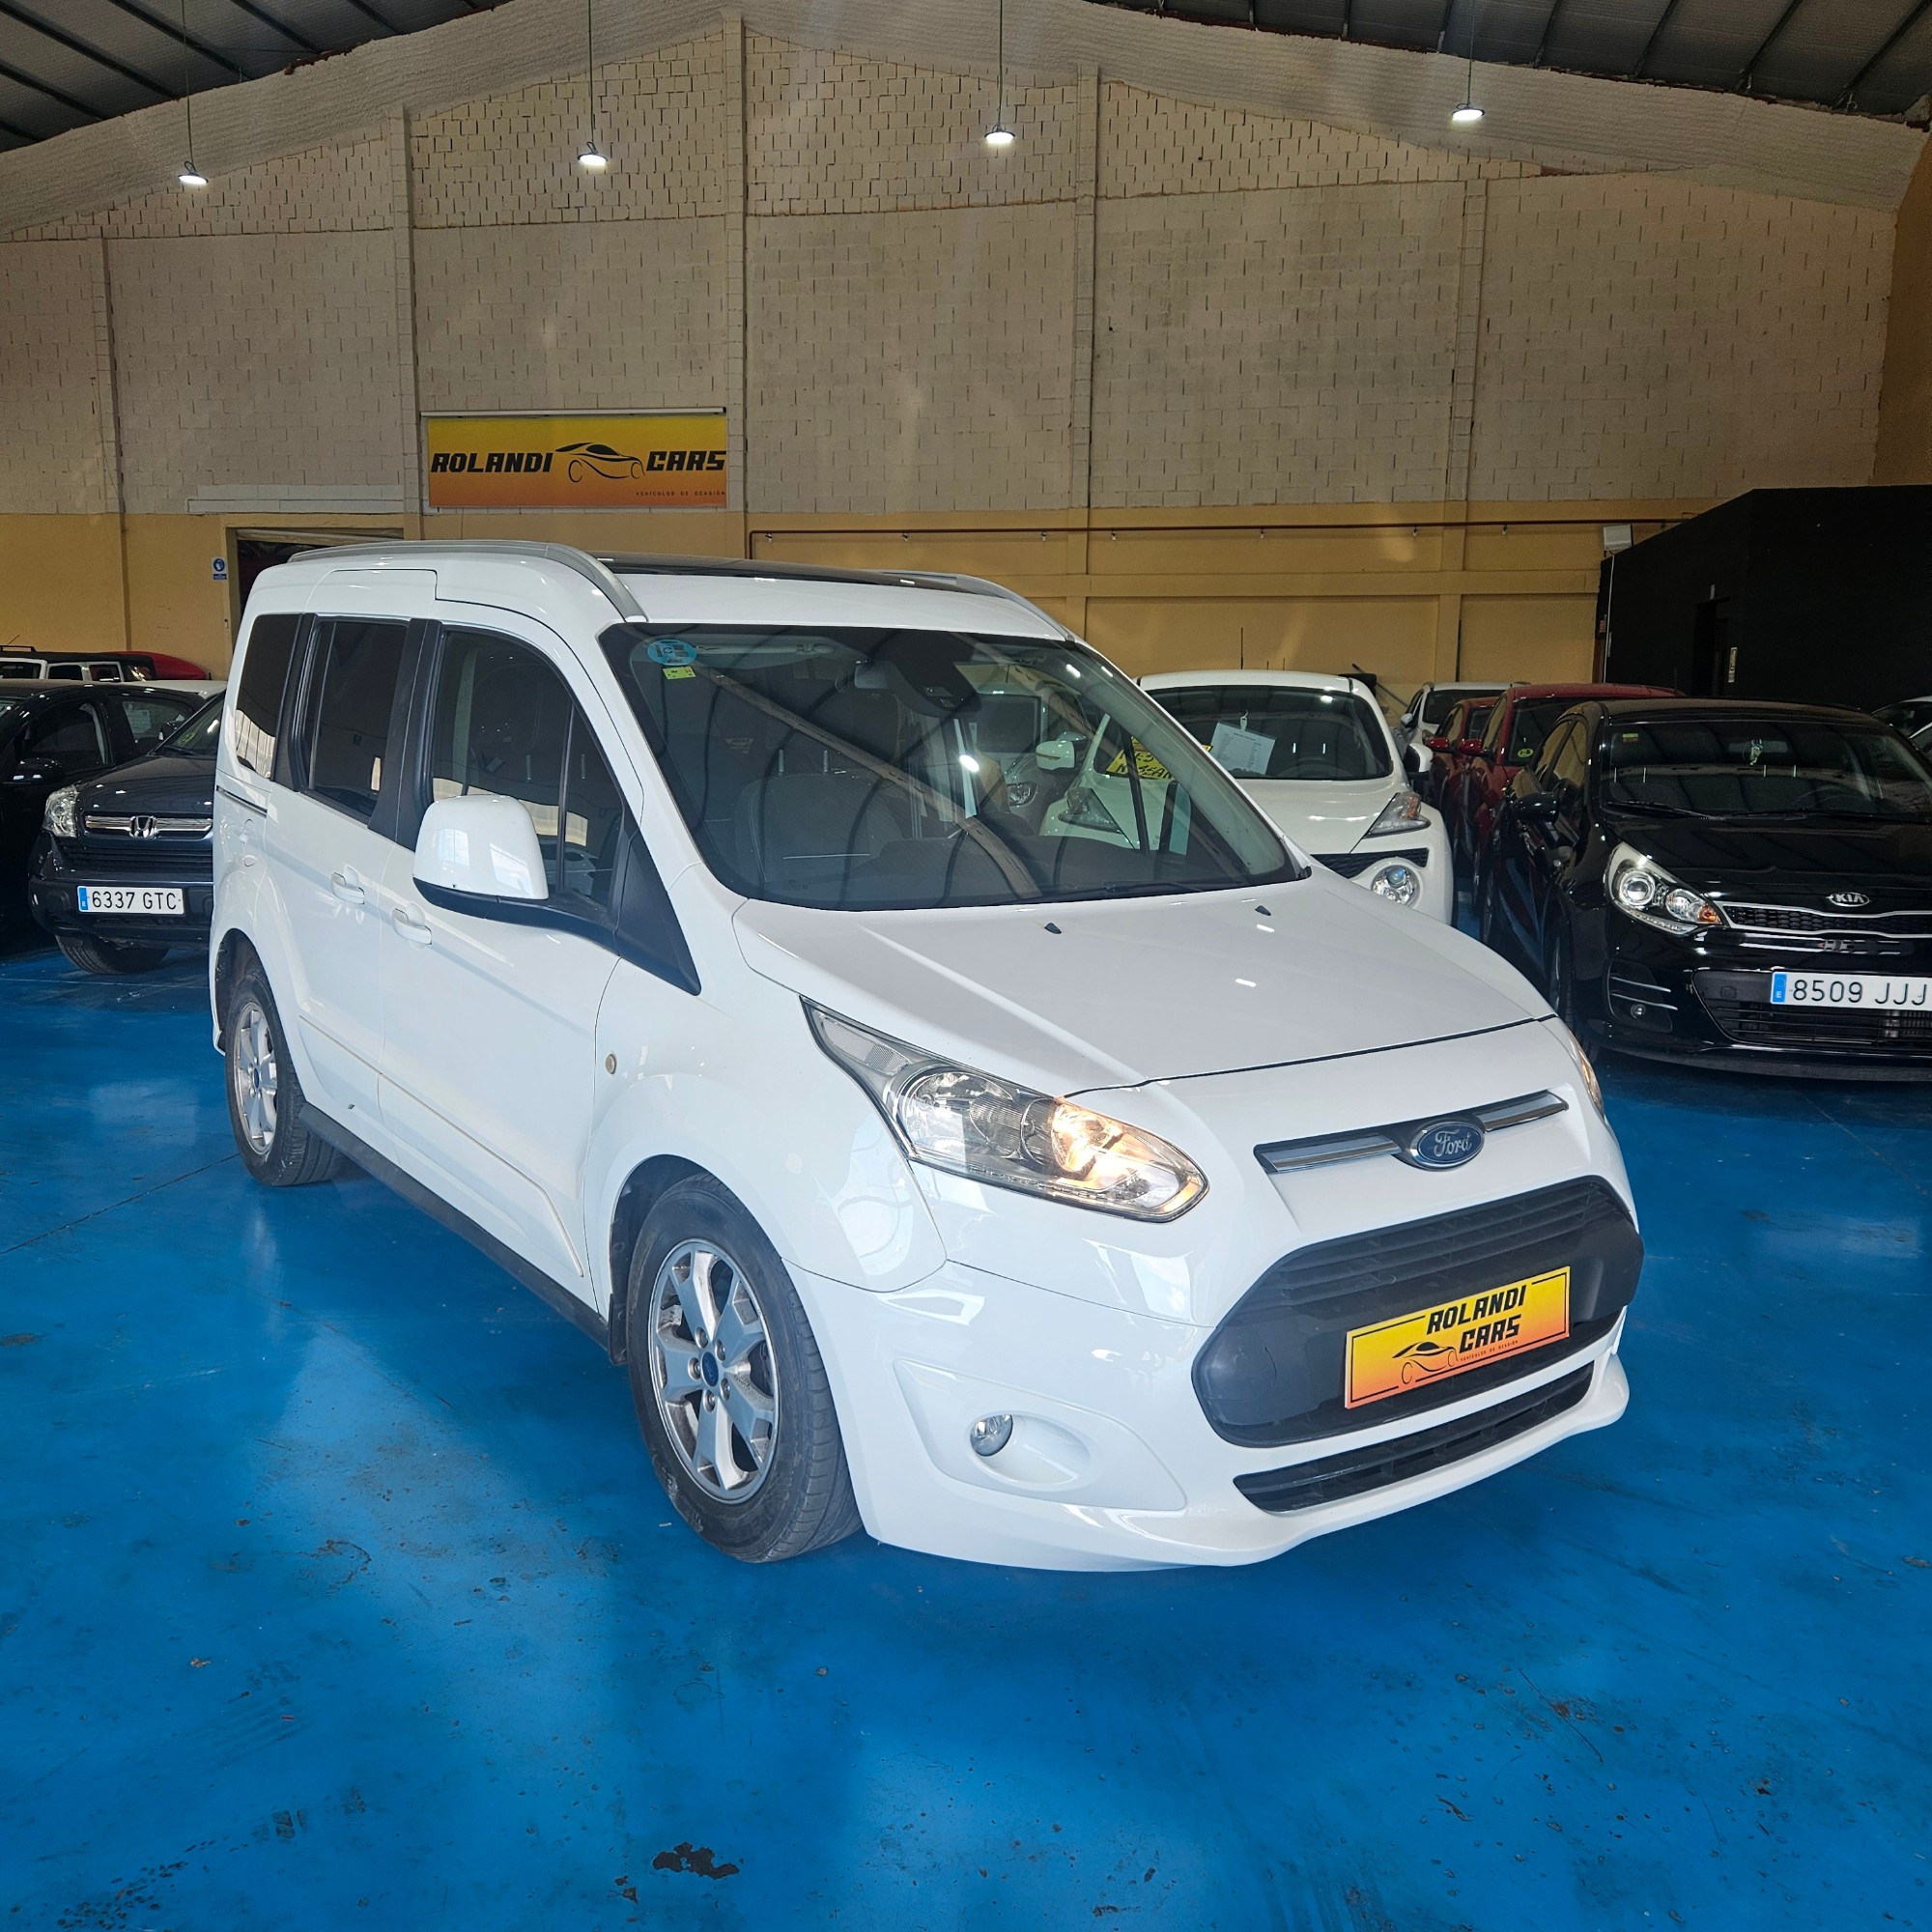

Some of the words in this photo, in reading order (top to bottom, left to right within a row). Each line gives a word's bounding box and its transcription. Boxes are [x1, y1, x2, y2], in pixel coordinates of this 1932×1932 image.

[431, 452, 554, 472] ROLANDI
[645, 450, 726, 471] CARS
[1116, 762, 1174, 780] NSSAN
[92, 891, 135, 910] 6337
[142, 892, 177, 910] GTC
[1835, 894, 1865, 903] KIA
[1792, 979, 1863, 1004] 8509
[1874, 981, 1928, 1007] JJJ
[1434, 1128, 1472, 1157] Ford
[1426, 1284, 1527, 1335] ROLANDI
[1459, 1314, 1522, 1354] CARS
